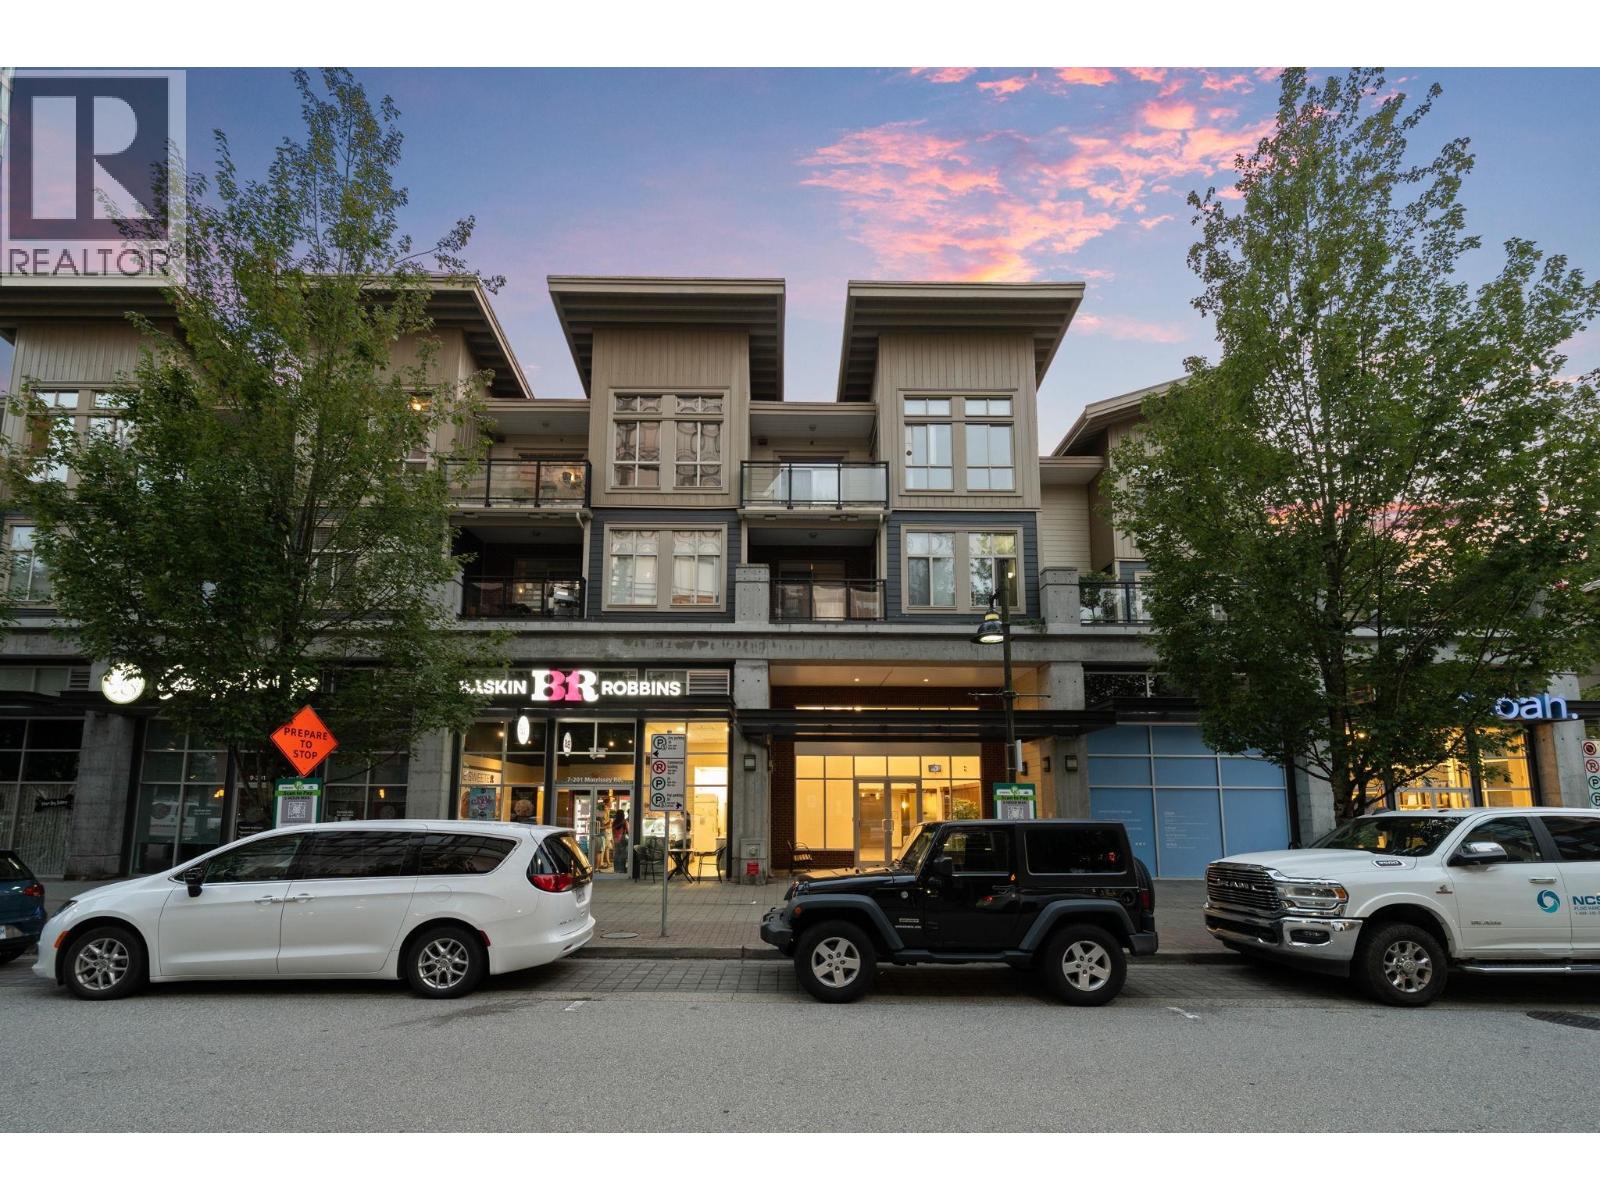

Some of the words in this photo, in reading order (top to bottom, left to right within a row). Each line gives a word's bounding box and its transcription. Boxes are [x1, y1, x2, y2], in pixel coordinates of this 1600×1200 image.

[601, 680, 682, 696] ROBBINS
[284, 727, 328, 740] PREPARE
[300, 740, 313, 749] TO
[293, 750, 318, 760] STOP
